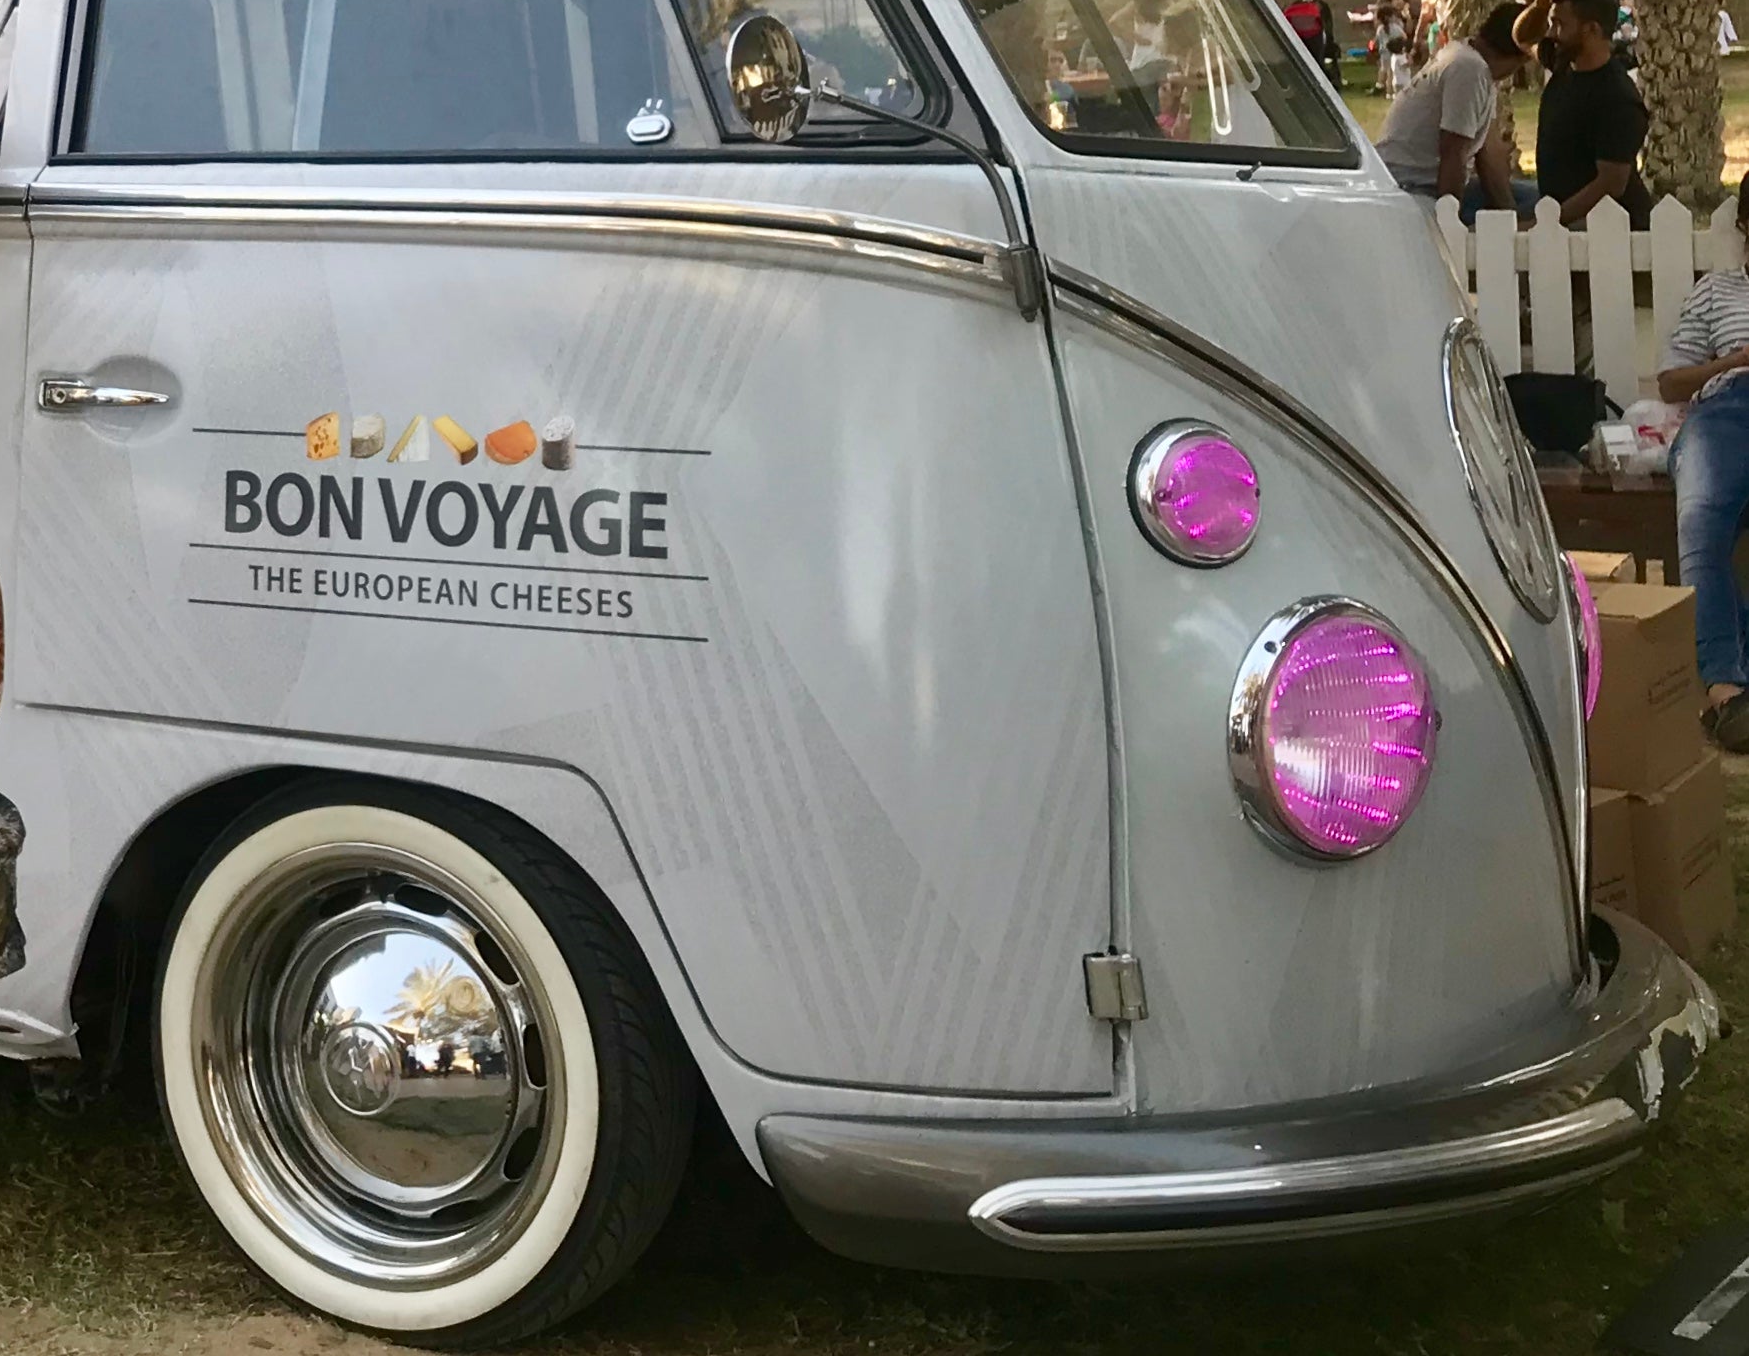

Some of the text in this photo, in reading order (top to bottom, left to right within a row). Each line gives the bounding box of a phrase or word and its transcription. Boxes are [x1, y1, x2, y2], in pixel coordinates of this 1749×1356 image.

[225, 470, 669, 560] BON VOYAGE
[249, 564, 633, 619] THE EUROPEAN CHEESES
